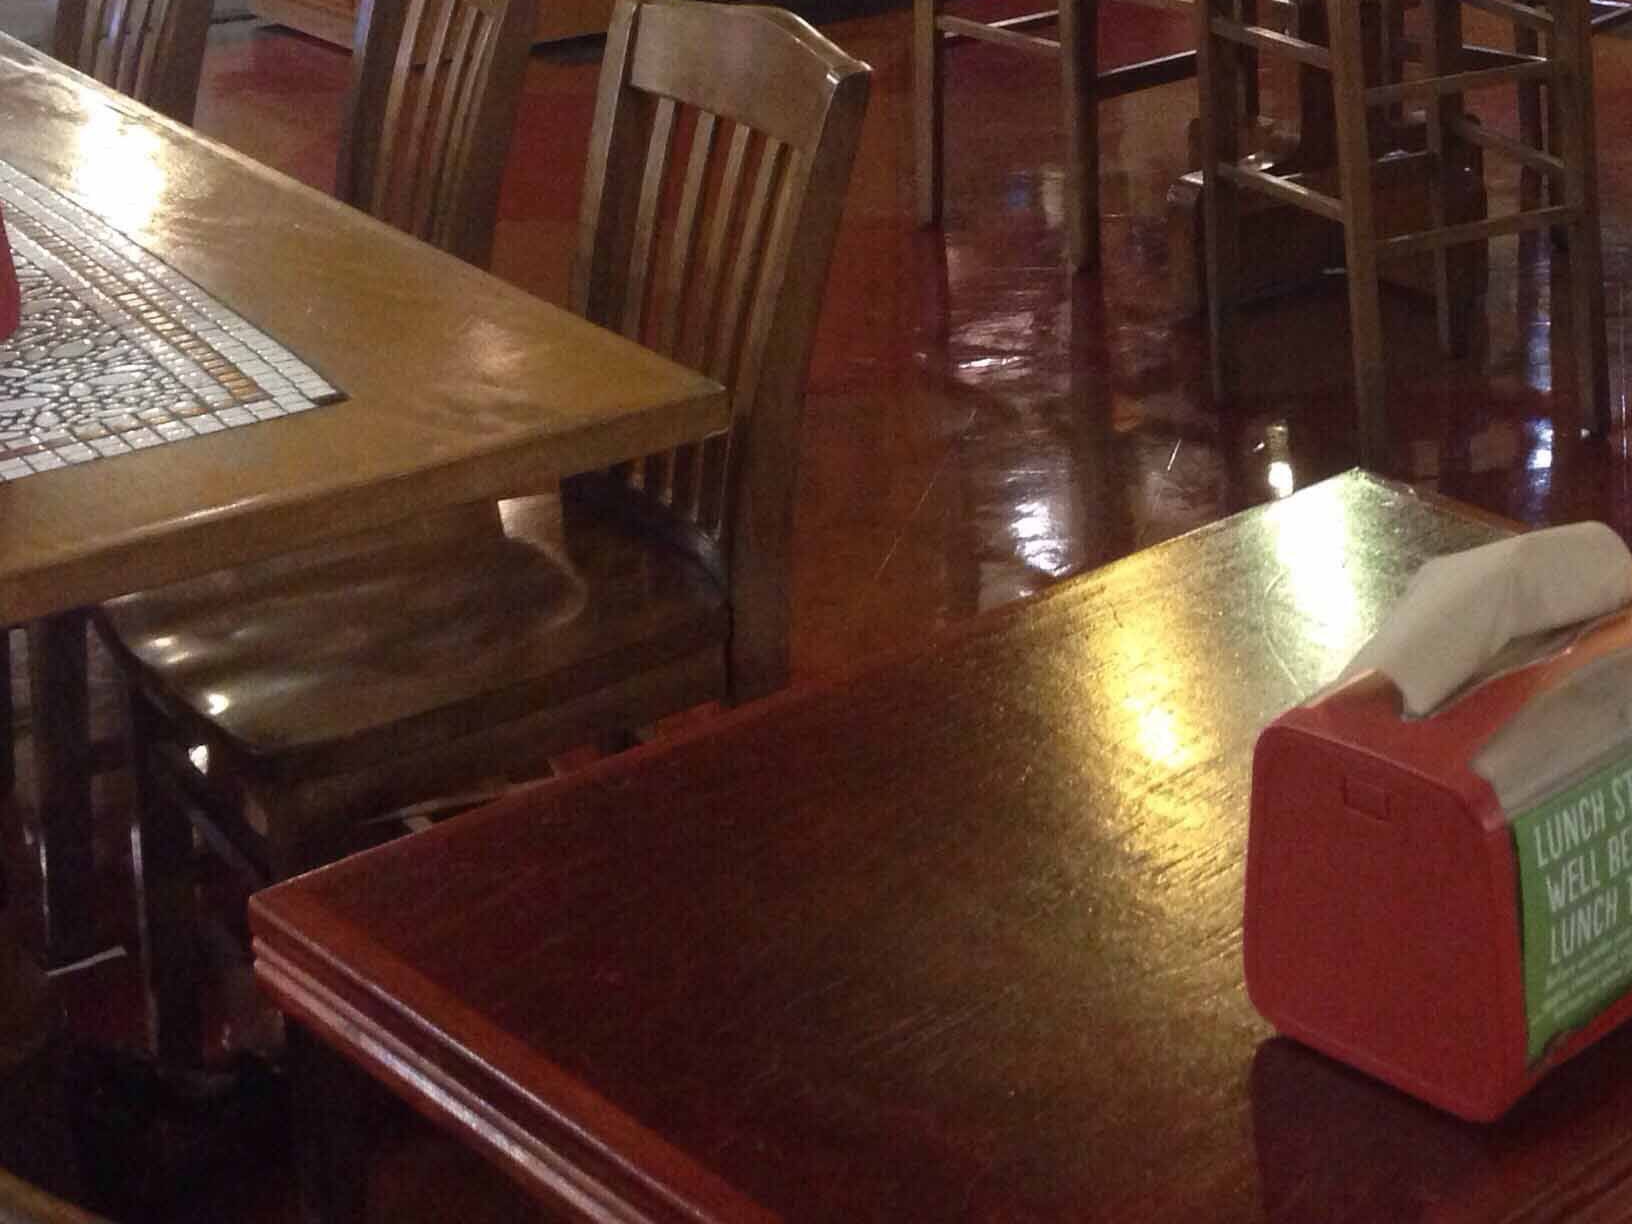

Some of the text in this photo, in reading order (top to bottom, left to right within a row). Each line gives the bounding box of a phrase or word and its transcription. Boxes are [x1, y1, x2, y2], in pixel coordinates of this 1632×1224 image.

[1532, 791, 1607, 868] LUNCH
[1545, 849, 1602, 914] WELL
[1549, 885, 1618, 964] LUNCH
